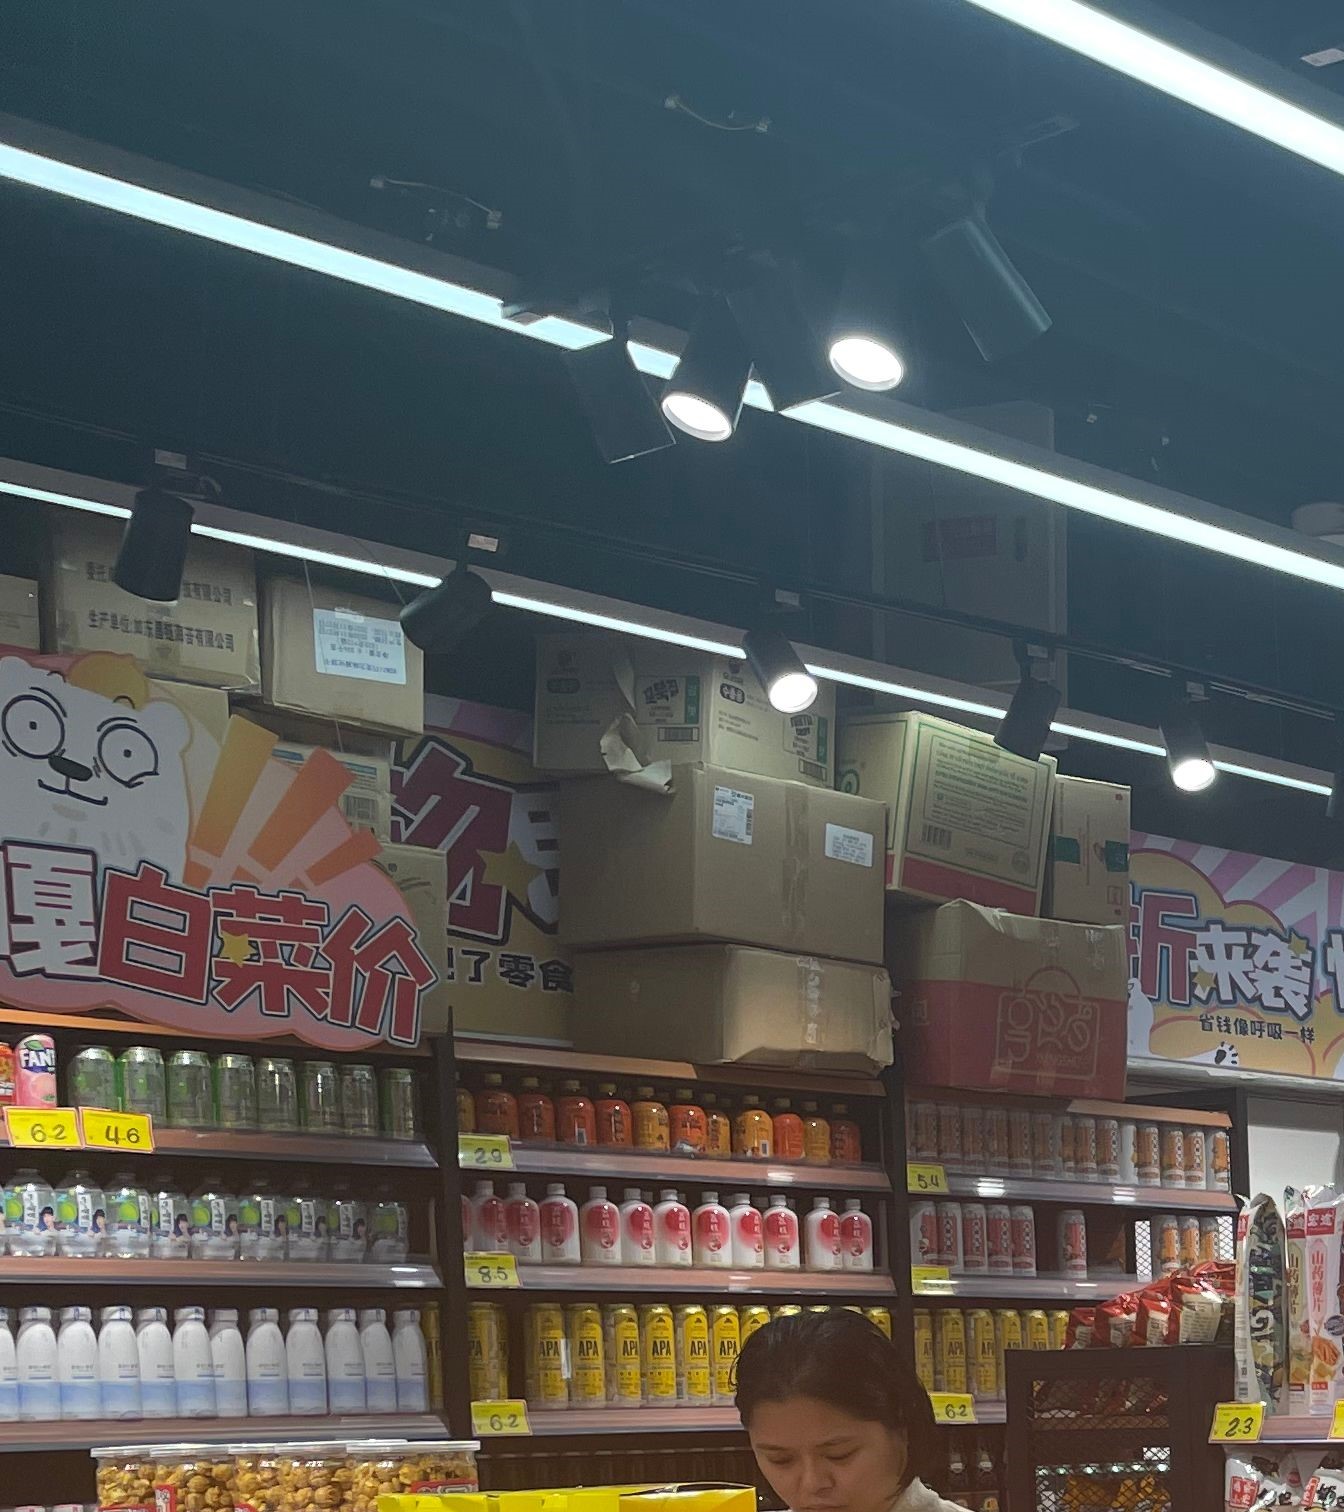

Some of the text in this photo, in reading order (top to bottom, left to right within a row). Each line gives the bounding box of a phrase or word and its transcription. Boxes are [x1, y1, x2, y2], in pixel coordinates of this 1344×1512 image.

[1200, 1013, 1315, 1044] 省钱像呼吸一样
[652, 1339, 672, 1357] APA
